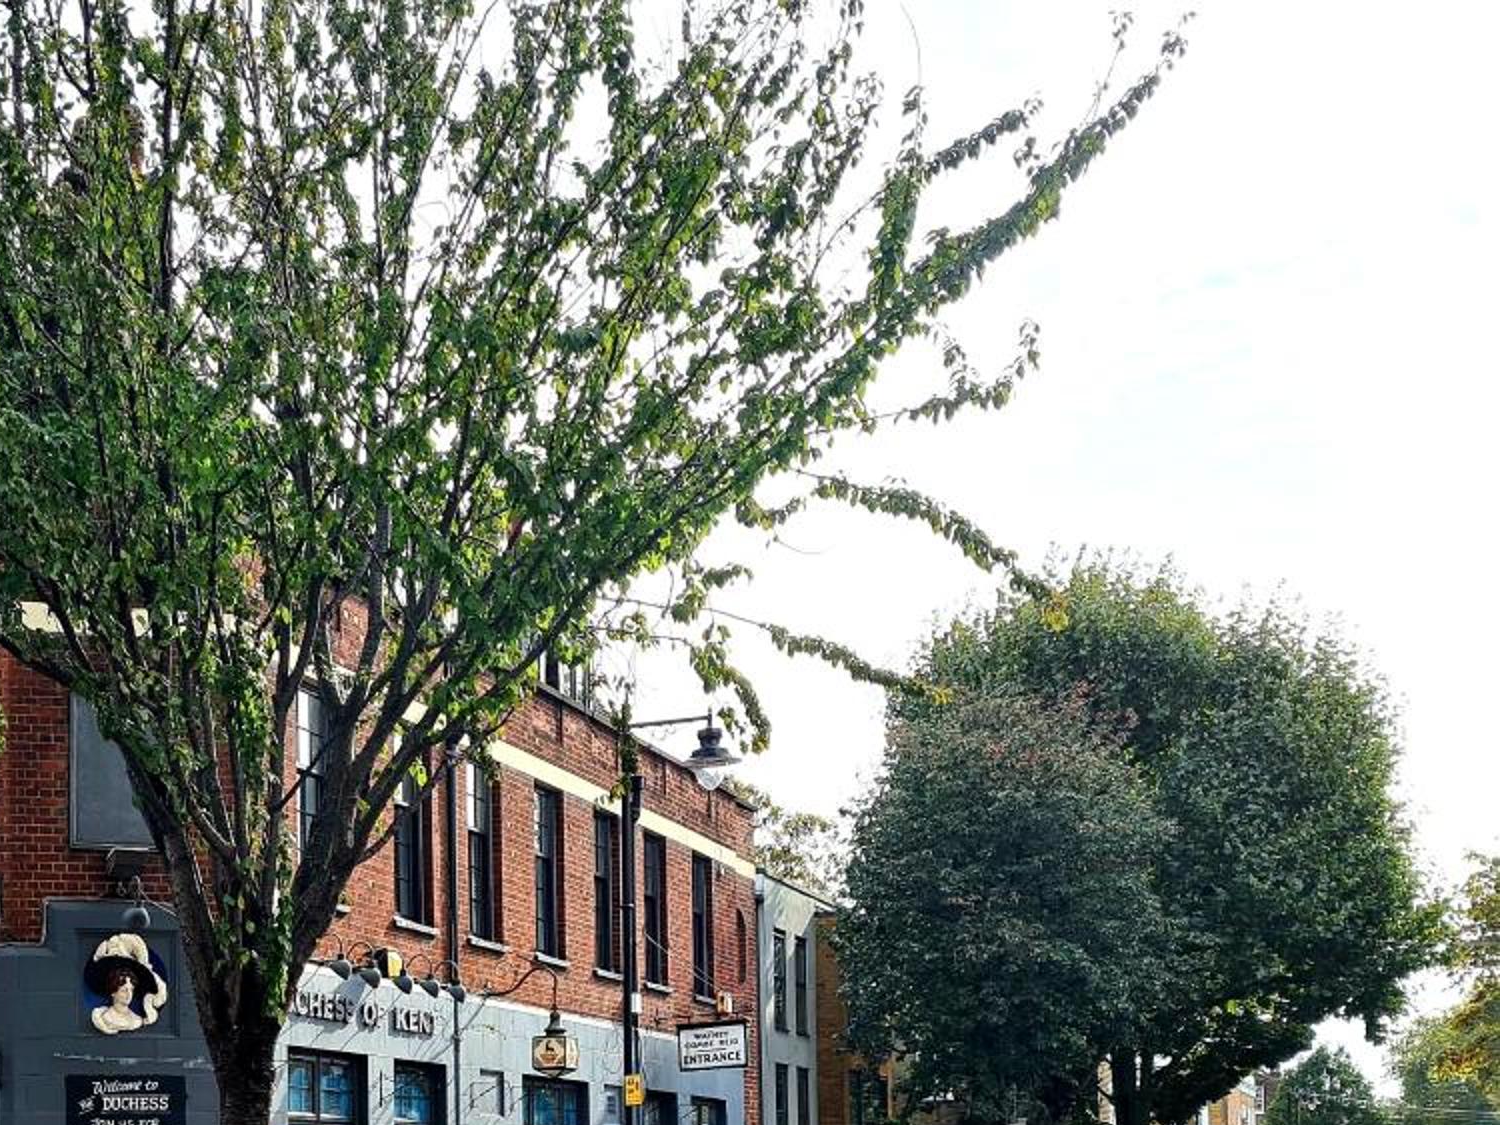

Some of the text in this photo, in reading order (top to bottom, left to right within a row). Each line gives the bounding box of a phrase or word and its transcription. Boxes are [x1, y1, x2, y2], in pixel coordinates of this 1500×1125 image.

[394, 1008, 443, 1034] KENT
[683, 1051, 742, 1065] ENTRANCE
[92, 1080, 159, 1095] Welcome to
[103, 1097, 169, 1111] DUCHESS
